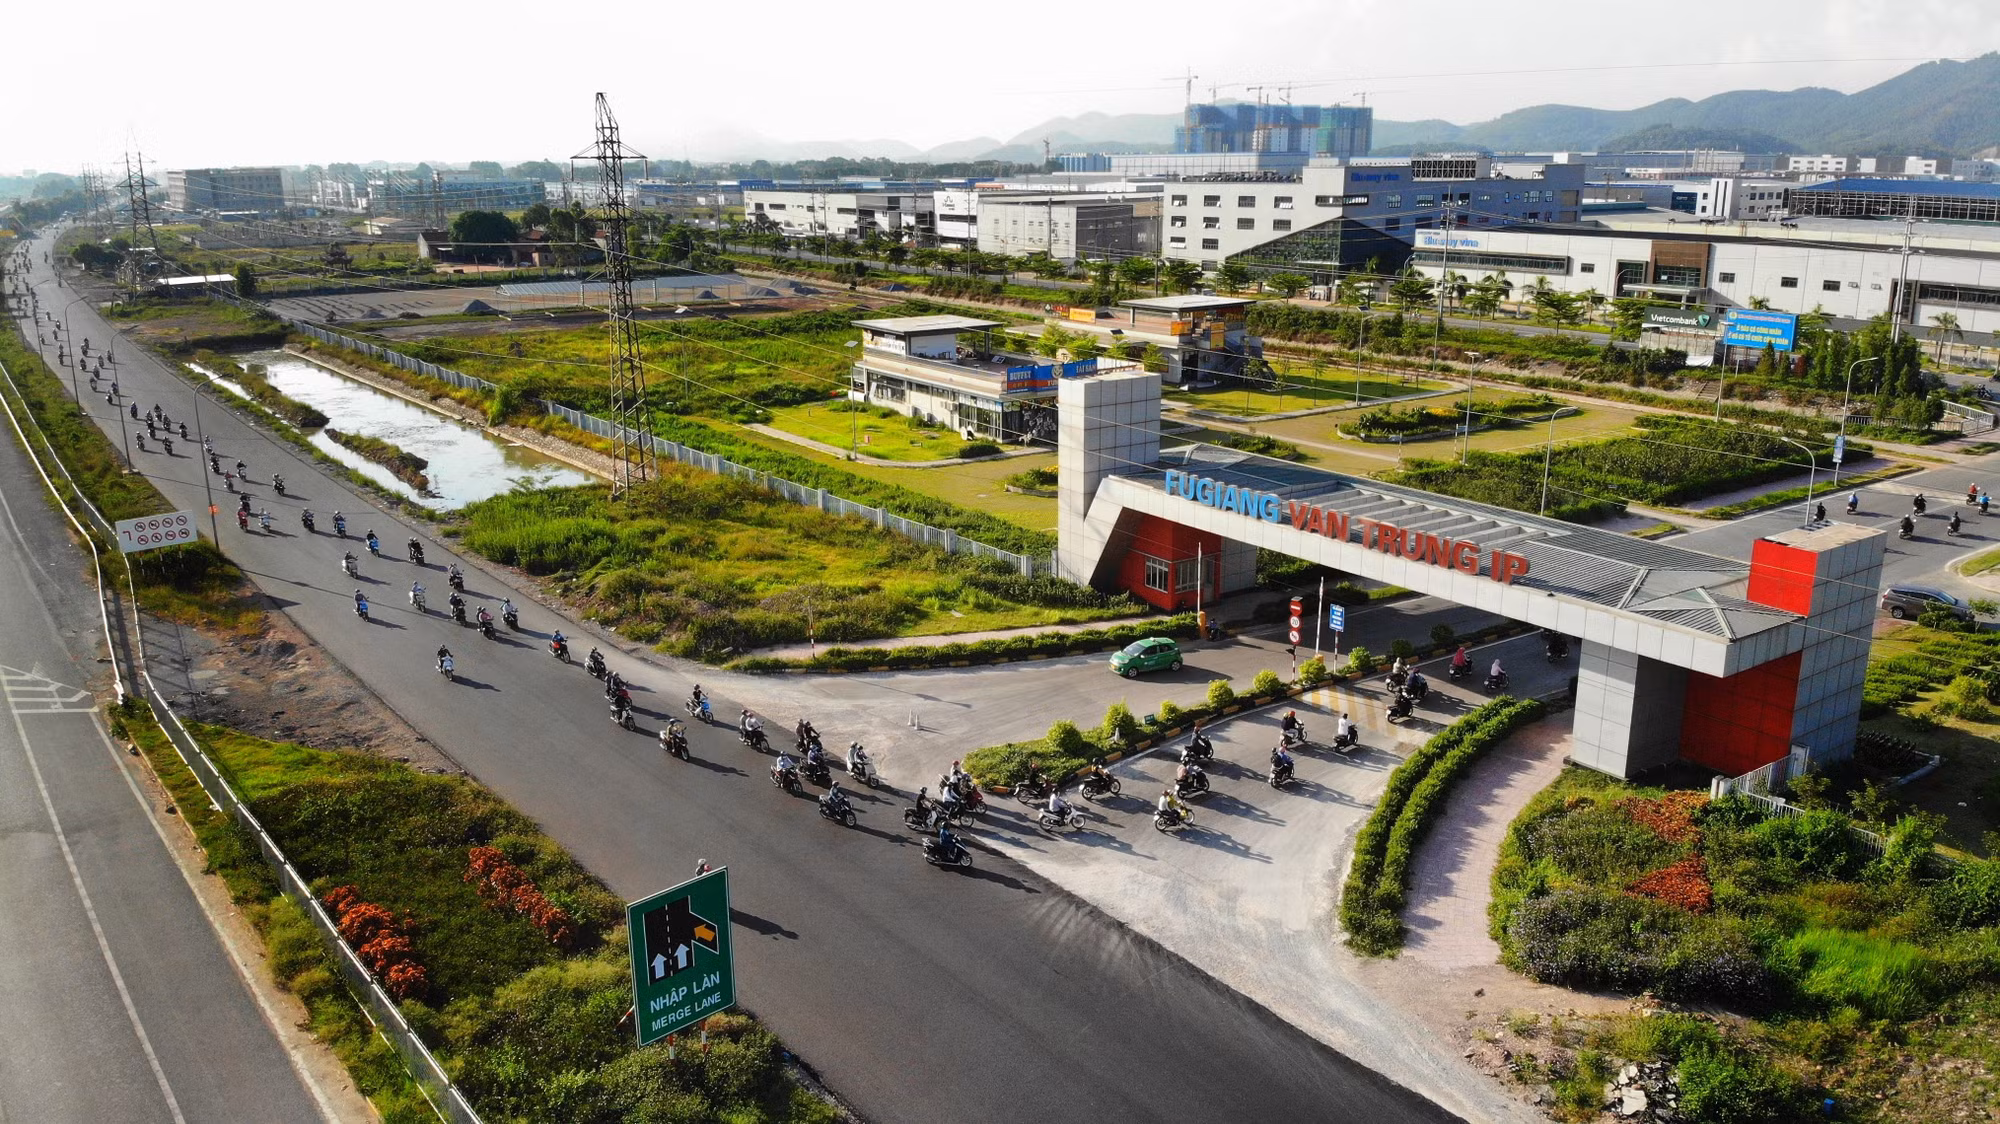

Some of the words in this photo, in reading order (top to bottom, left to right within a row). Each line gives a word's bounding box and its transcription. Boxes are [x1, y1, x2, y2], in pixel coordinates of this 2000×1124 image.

[1651, 314, 1699, 326] Vietcombank
[1010, 370, 1031, 380] BUFFET
[1165, 469, 1282, 523] FUGIANG
[1289, 500, 1350, 542] VAN
[1358, 517, 1480, 575] TRUNG
[1491, 549, 1530, 584] IP
[650, 987, 688, 1013] NHẬP
[693, 971, 720, 994] LÀN
[652, 1005, 692, 1031] MERGE
[695, 992, 721, 1012] LANE
